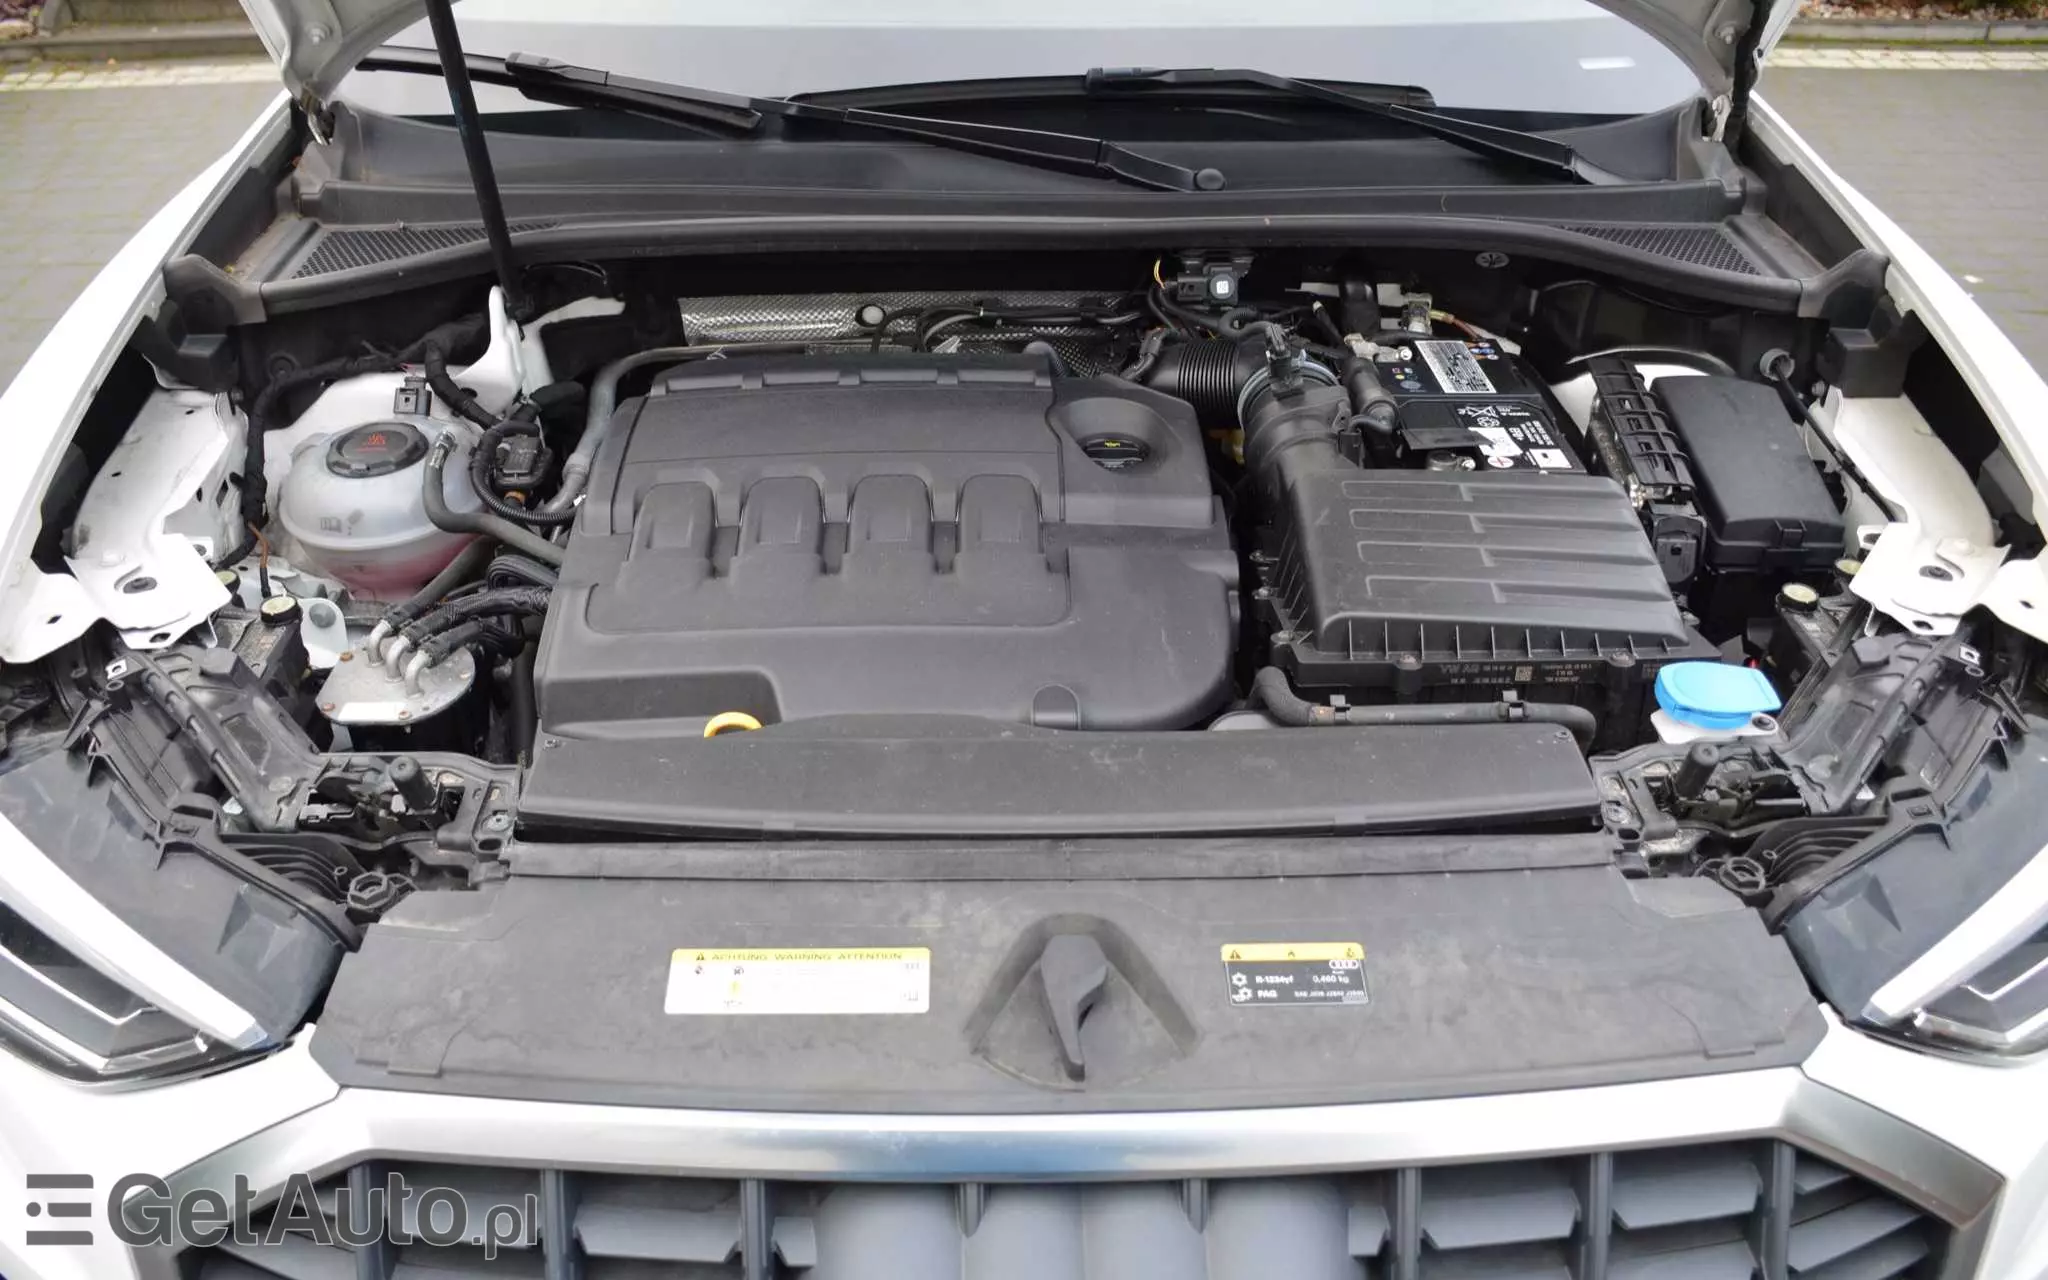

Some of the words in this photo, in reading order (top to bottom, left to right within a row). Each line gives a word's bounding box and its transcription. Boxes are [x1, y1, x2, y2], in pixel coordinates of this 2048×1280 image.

[711, 953, 768, 961] ACHTUNG
[774, 953, 832, 961] WARNING
[837, 953, 902, 961] ATTENTION
[1257, 989, 1278, 998] PAG
